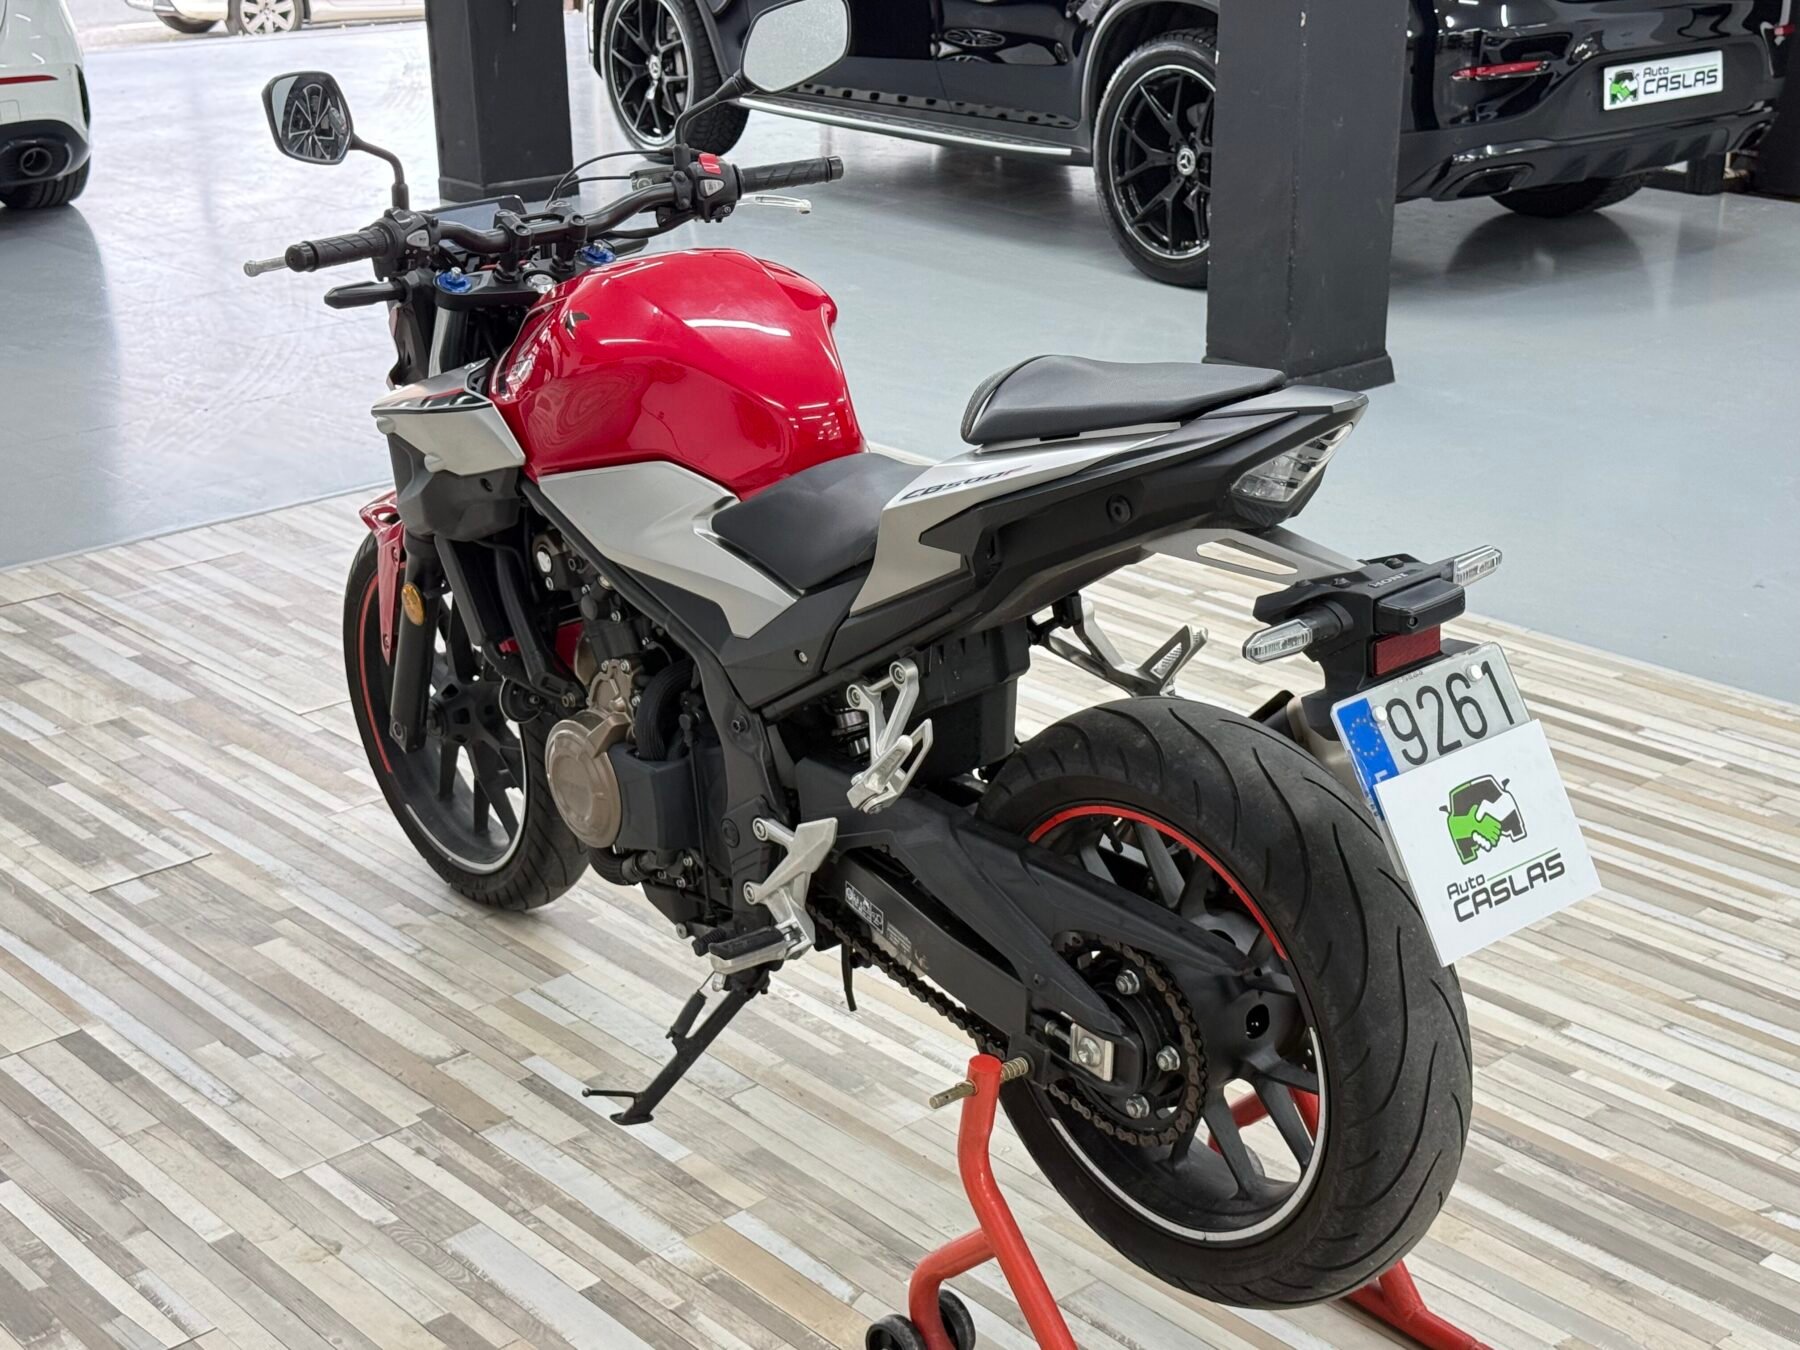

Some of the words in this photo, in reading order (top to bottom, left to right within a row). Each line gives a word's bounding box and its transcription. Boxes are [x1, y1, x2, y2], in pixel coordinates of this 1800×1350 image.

[1643, 66, 1670, 78] Auto
[1643, 68, 1719, 95] CASLAS
[1386, 660, 1515, 766] 9261
[1446, 874, 1486, 901] Auto
[1453, 852, 1566, 923] CASLAS
